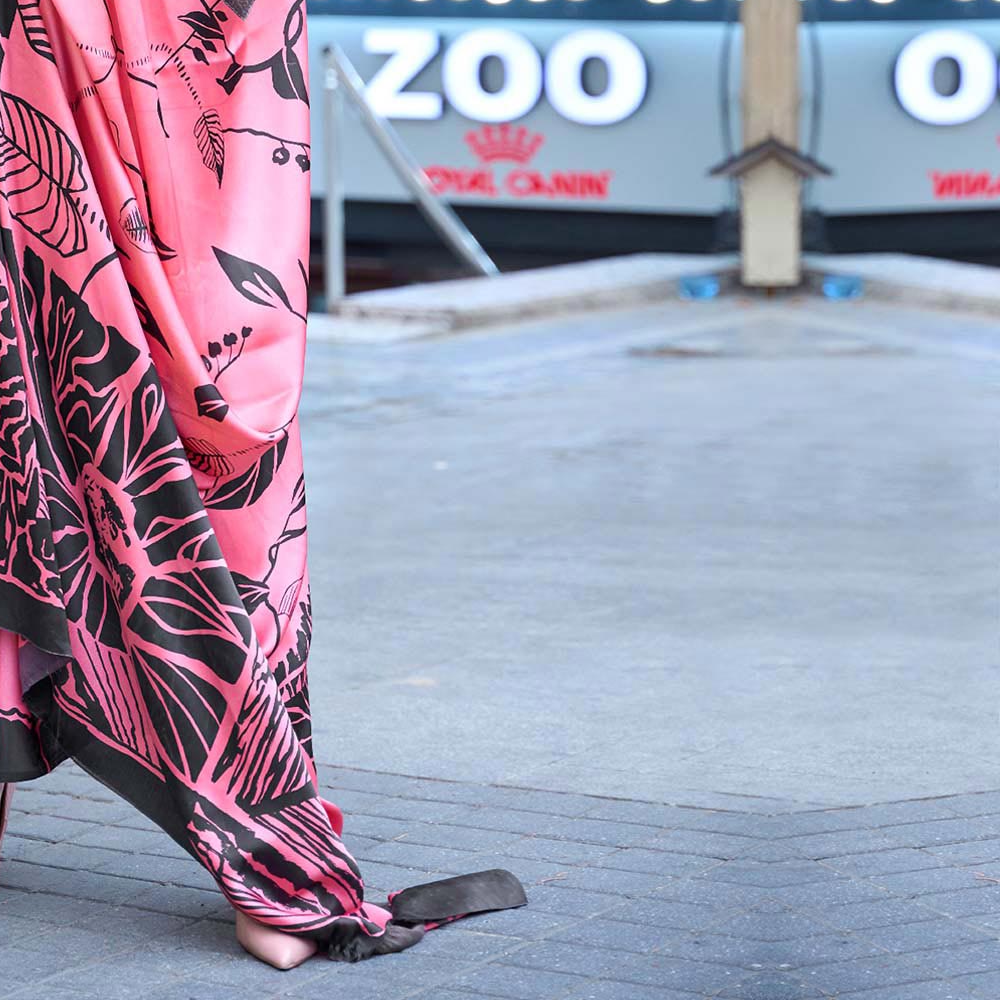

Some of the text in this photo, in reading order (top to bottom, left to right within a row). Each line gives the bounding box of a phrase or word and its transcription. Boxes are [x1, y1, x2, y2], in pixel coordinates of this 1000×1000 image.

[363, 28, 648, 125] ZOO
[421, 166, 610, 198] OYAL CANIN
